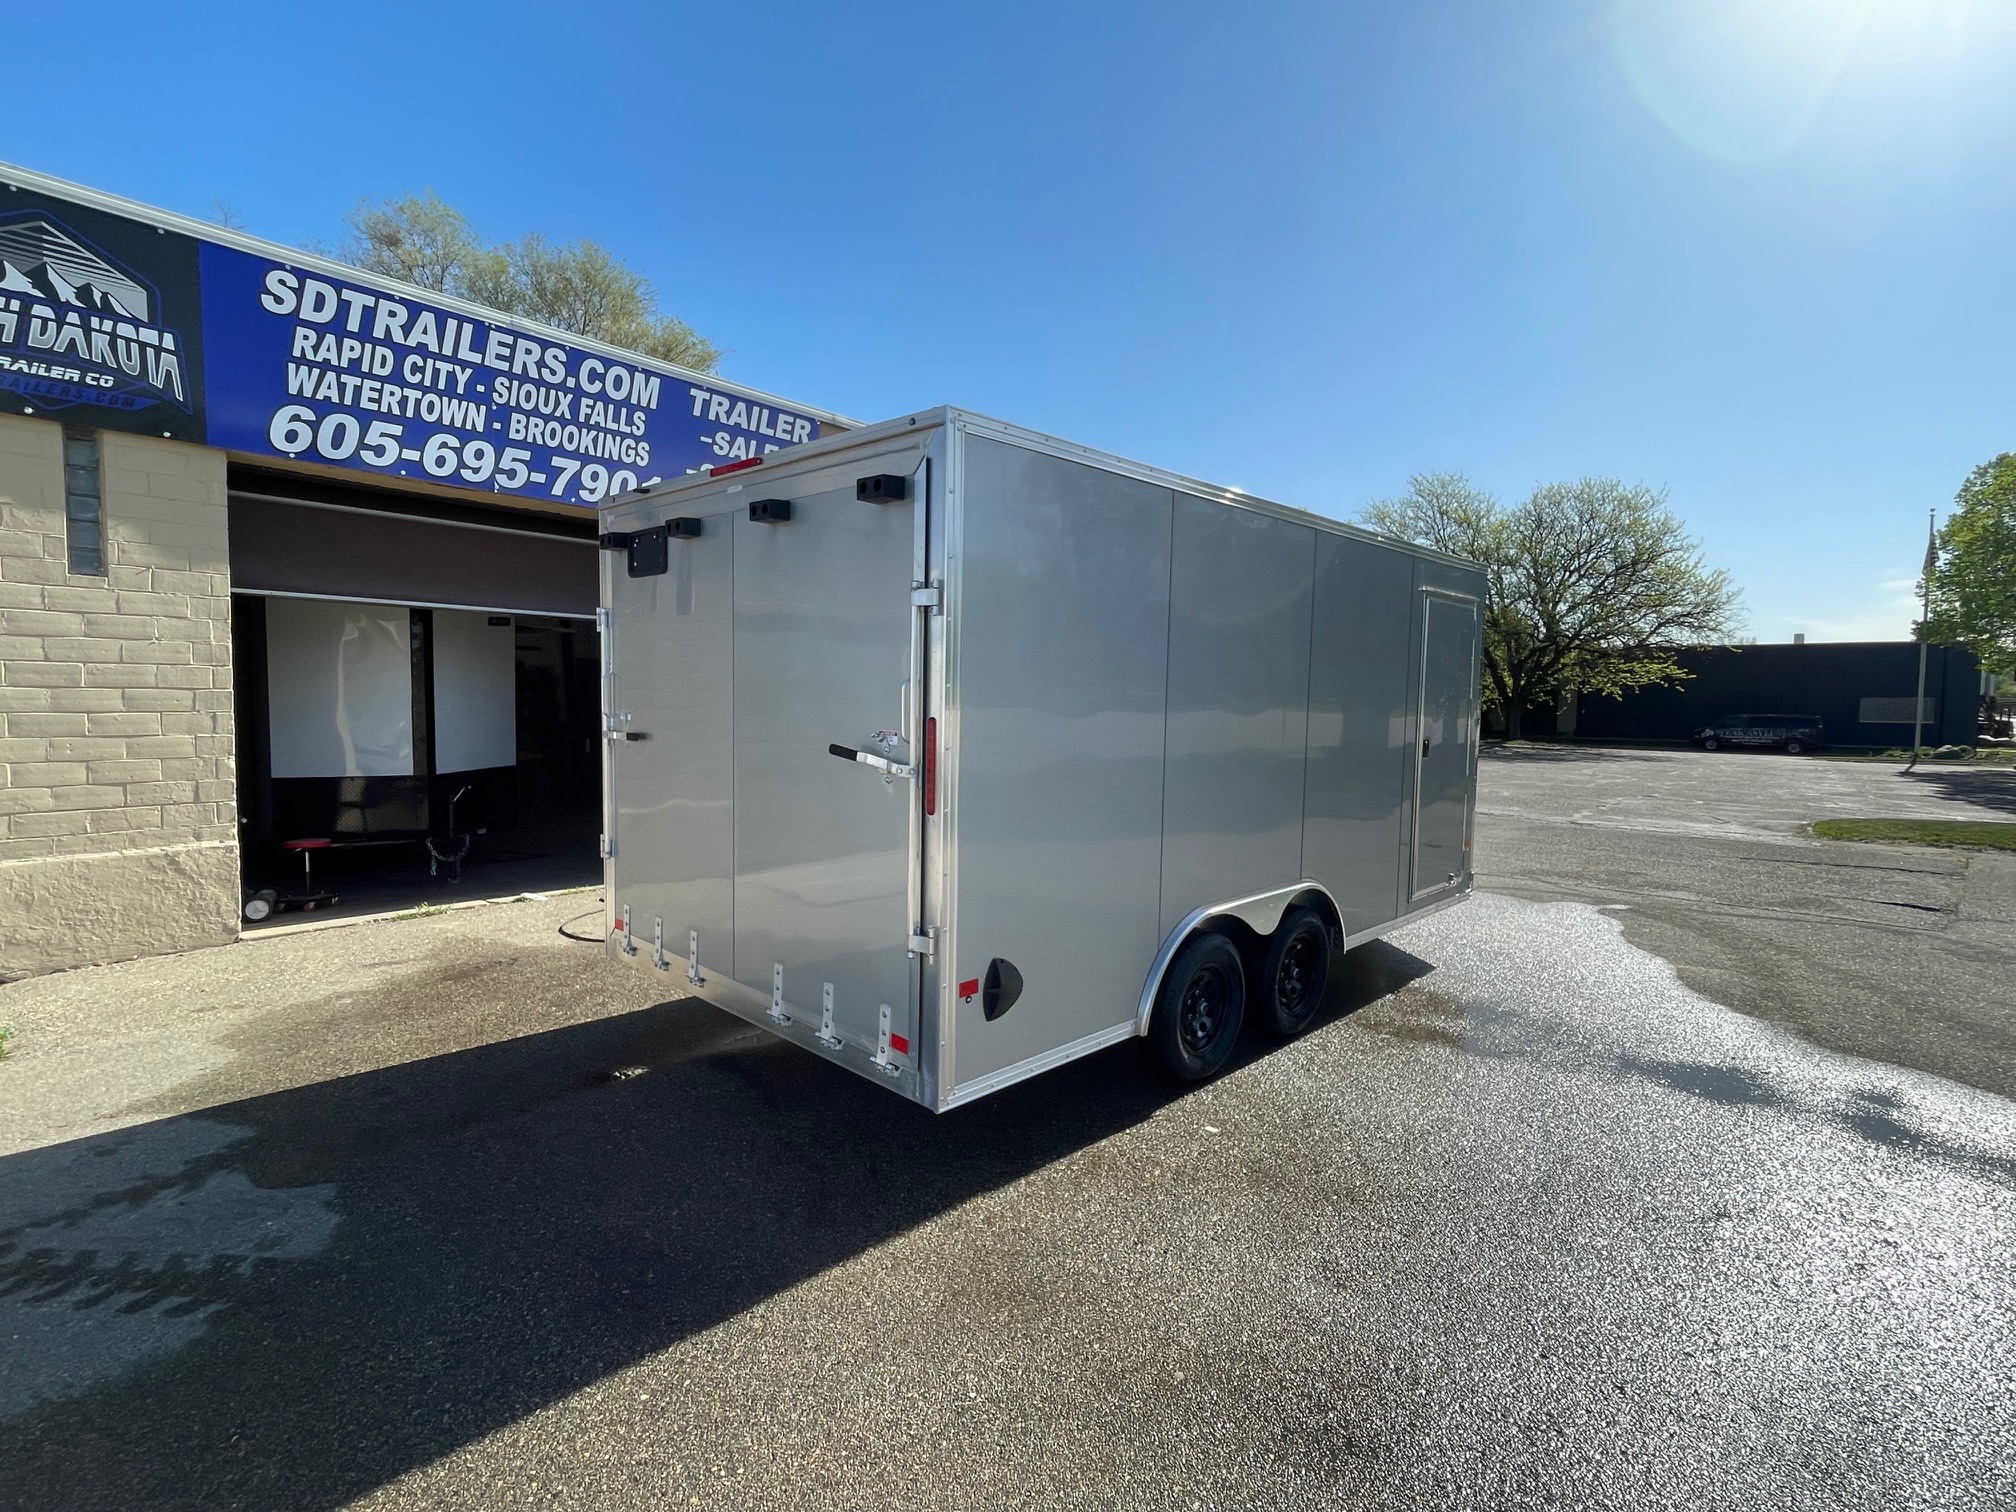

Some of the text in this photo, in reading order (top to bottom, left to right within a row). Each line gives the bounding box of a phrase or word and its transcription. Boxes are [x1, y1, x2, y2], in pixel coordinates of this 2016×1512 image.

[85, 372, 115, 388] CO
[260, 269, 661, 410] SDTRAILERS.COM
[293, 326, 395, 377] RAPID
[403, 352, 474, 394] CITY
[492, 376, 572, 420] SIOUX
[579, 398, 646, 437] FALLS
[269, 405, 662, 503] 605-695-790
[286, 362, 486, 433] WATERTOWN
[508, 413, 650, 467] BROOKINGS
[689, 387, 812, 444] TRAILER
